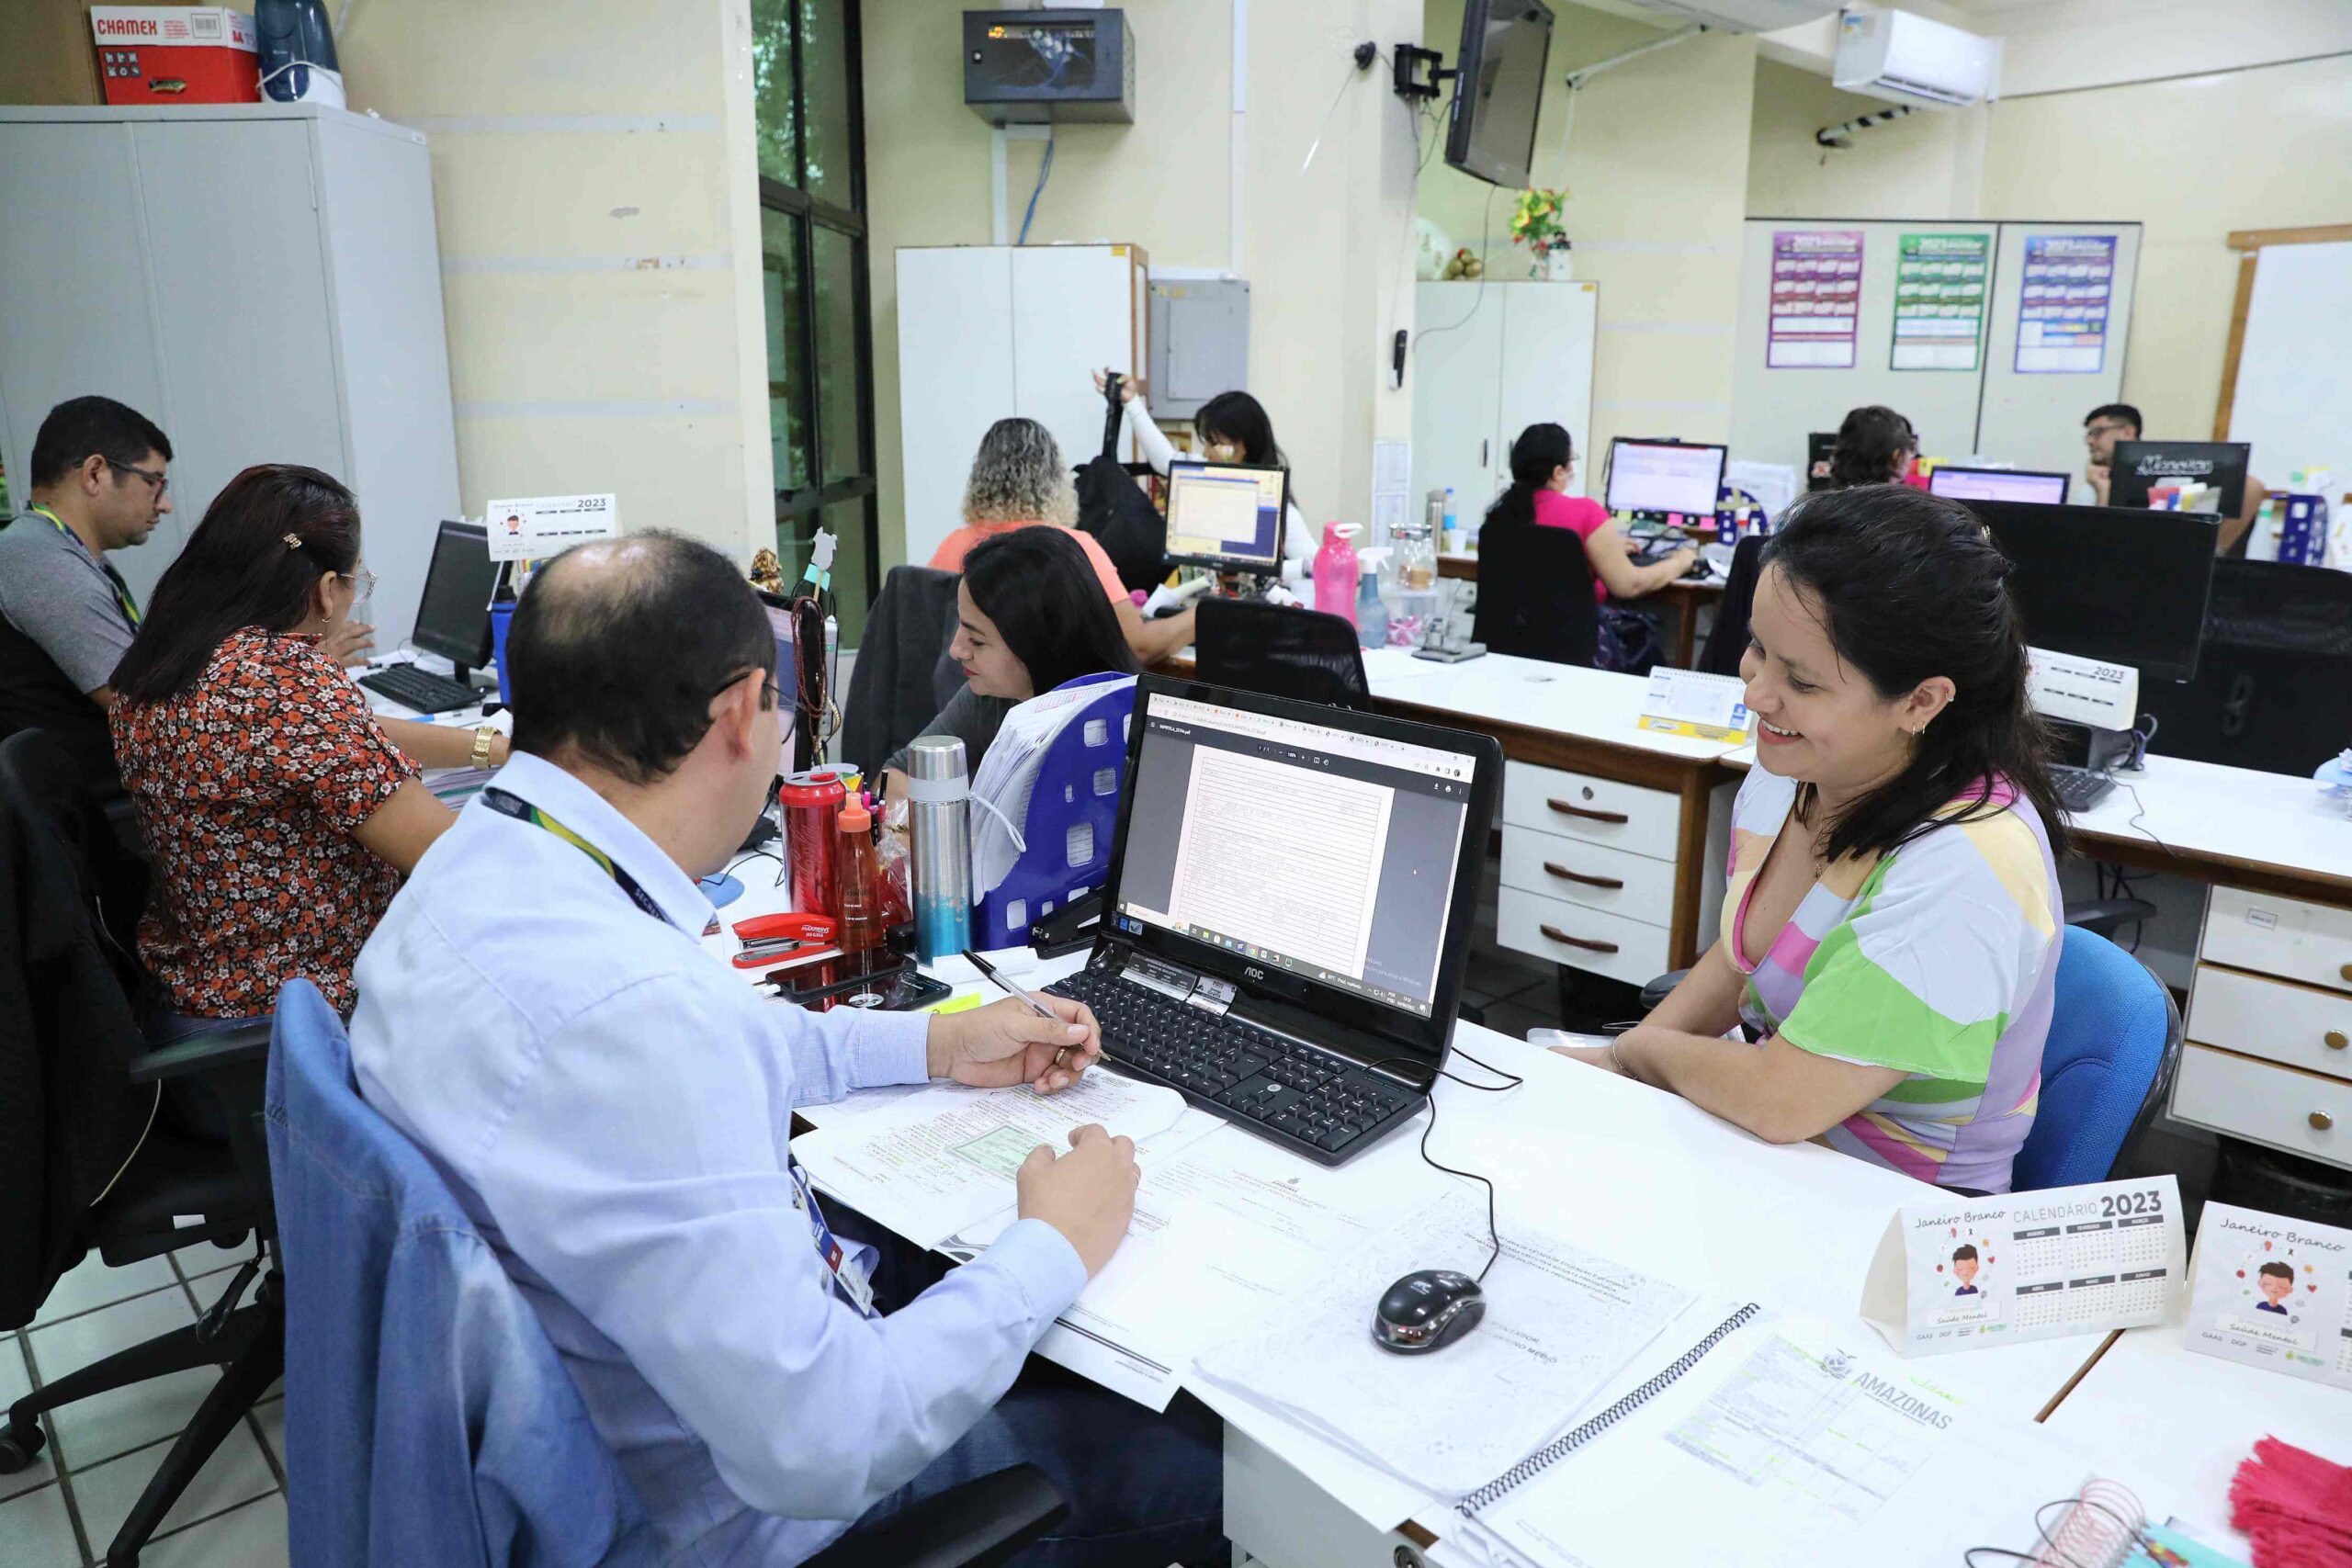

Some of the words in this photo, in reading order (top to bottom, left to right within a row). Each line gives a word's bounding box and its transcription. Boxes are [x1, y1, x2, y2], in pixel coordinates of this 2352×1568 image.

[97, 19, 157, 36] CHAMEX
[578, 499, 606, 507] 2023
[2094, 667, 2124, 679] 2023
[1244, 967, 1264, 980] AOC
[1915, 1215, 1962, 1228] Janeiro
[1963, 1210, 2006, 1223] Branco
[2013, 1202, 2098, 1224] CALENDÁRIO
[2100, 1190, 2162, 1217] 2023
[2220, 1218, 2282, 1238] Janeiro
[2286, 1231, 2346, 1252] Branco
[1937, 1315, 1960, 1325] Saúde
[1961, 1312, 1988, 1322] Mental
[2229, 1324, 2260, 1336] Saúde
[2262, 1332, 2299, 1346] Mental
[1854, 1371, 1953, 1430] AMAZONAS
